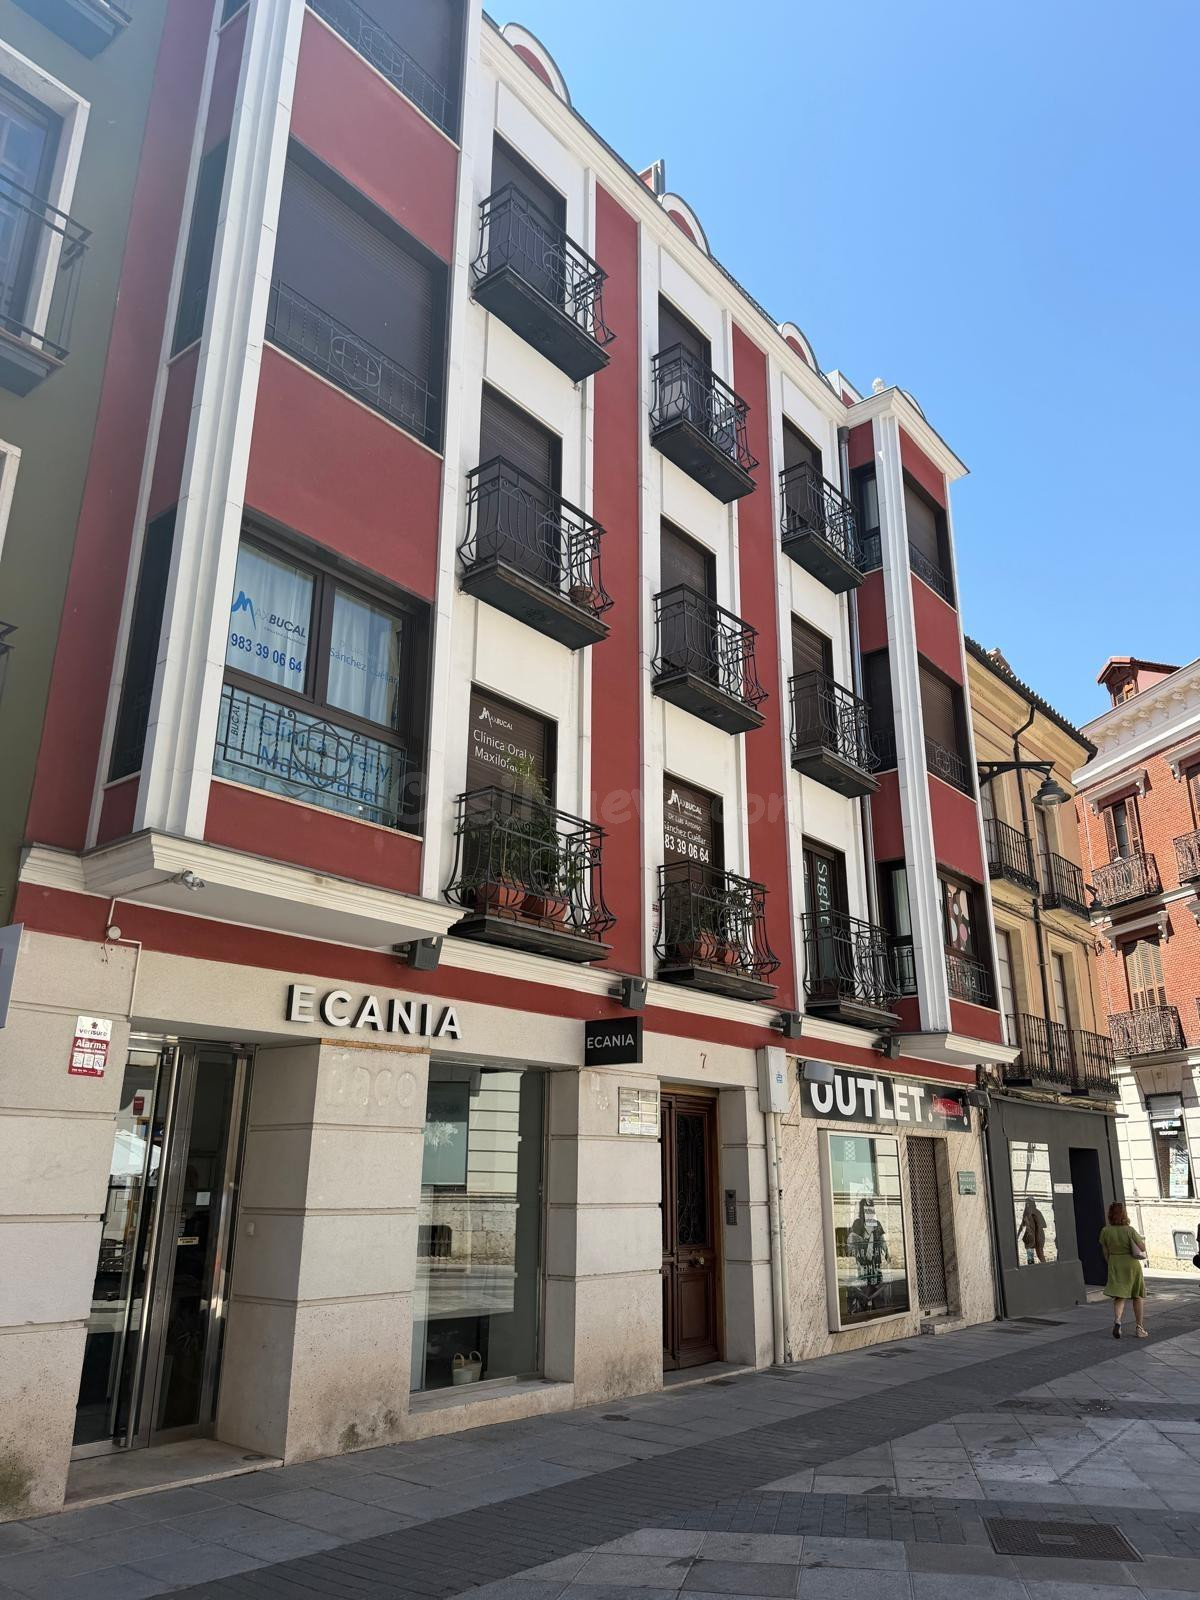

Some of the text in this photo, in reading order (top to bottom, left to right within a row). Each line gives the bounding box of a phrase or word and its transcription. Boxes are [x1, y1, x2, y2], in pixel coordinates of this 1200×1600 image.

[231, 633, 252, 652] 983
[255, 643, 269, 659] 39
[272, 650, 287, 667] 06
[289, 656, 302, 673] 64
[260, 713, 326, 752] Cínica
[380, 763, 390, 783] y
[473, 729, 535, 765] Clínica Oral y
[475, 746, 530, 777] Maxilofal
[677, 839, 686, 854] 39
[688, 843, 698, 859] 06
[700, 848, 709, 863] 64
[286, 984, 462, 1040] ECANIA
[76, 1039, 107, 1050] Alarma
[587, 1033, 635, 1049] ECANIA
[699, 1052, 708, 1069] 7
[811, 1074, 925, 1122] OUTLET
